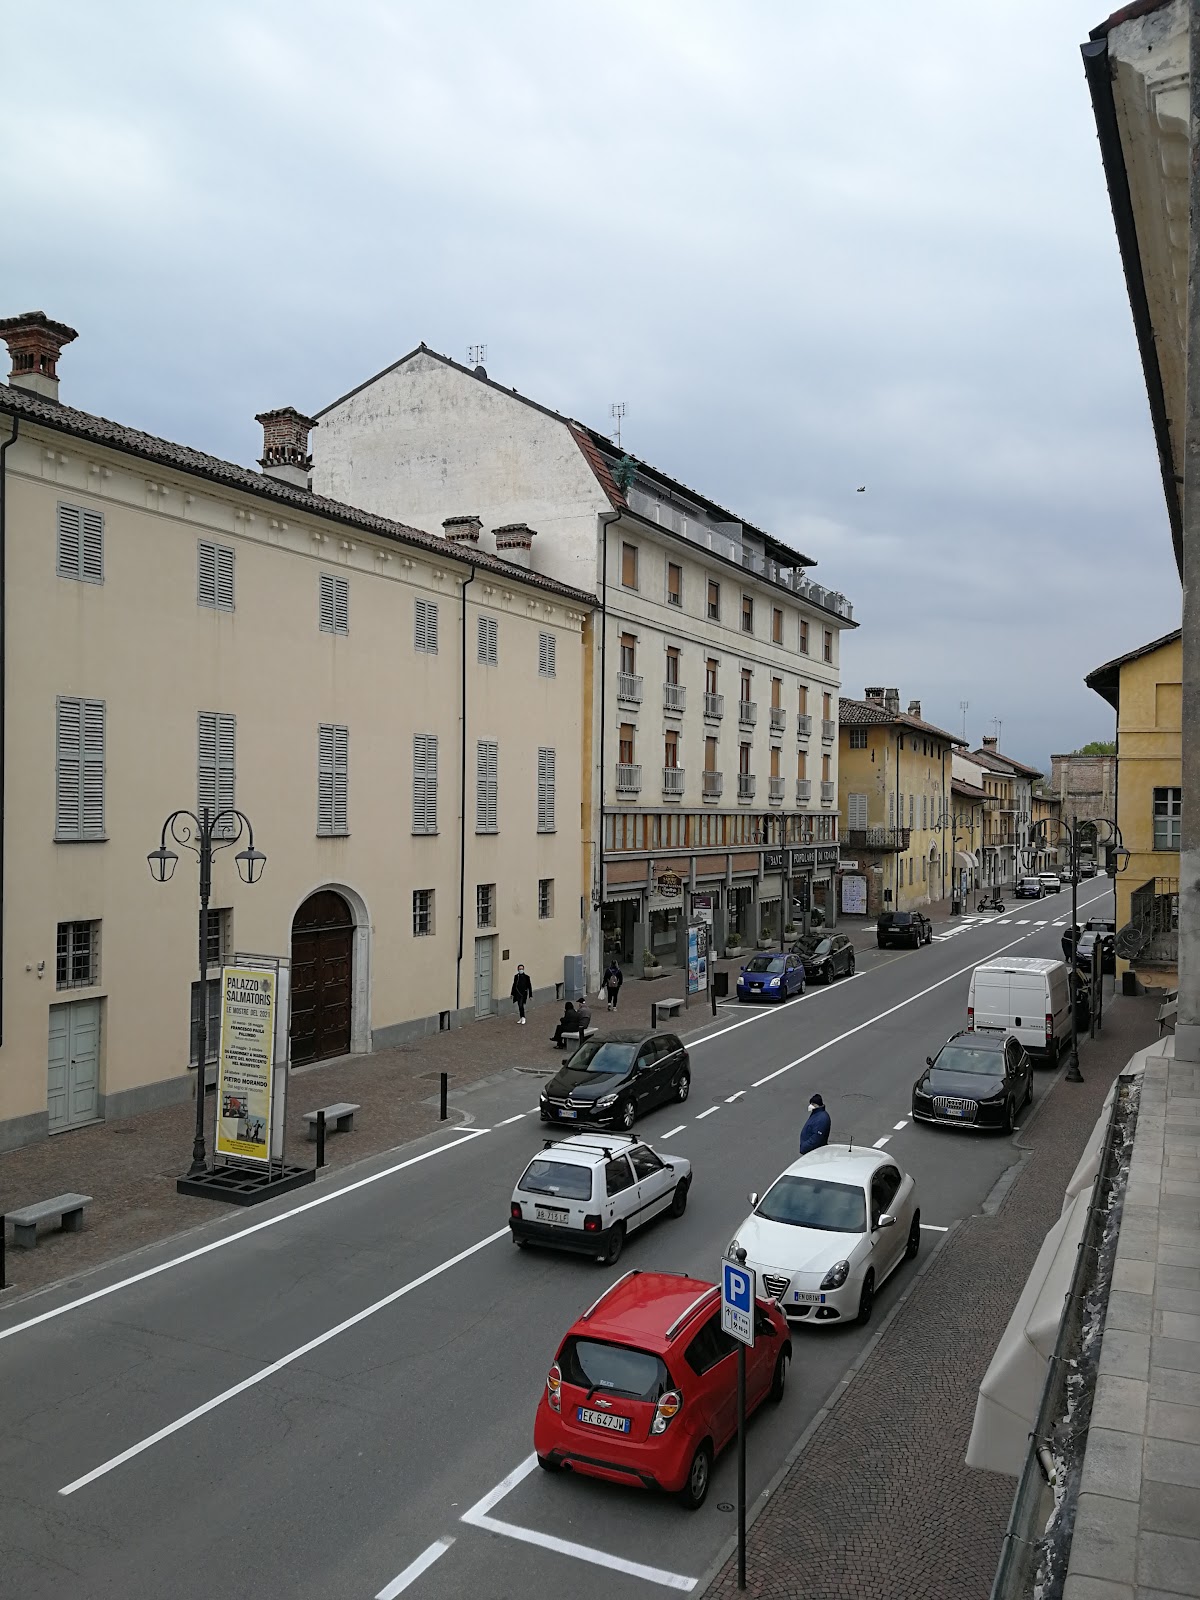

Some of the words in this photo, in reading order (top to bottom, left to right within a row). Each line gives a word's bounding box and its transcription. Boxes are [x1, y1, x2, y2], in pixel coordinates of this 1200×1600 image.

[794, 852, 815, 863] POPOLARE
[227, 978, 258, 991] PALAZZO
[226, 990, 272, 1006] SALMATORIS
[232, 1007, 249, 1016] MOSTRE
[242, 1079, 268, 1087] MORANDO
[730, 1272, 745, 1301] P
[584, 1410, 594, 1422] EK
[596, 1414, 624, 1430] 647JW
